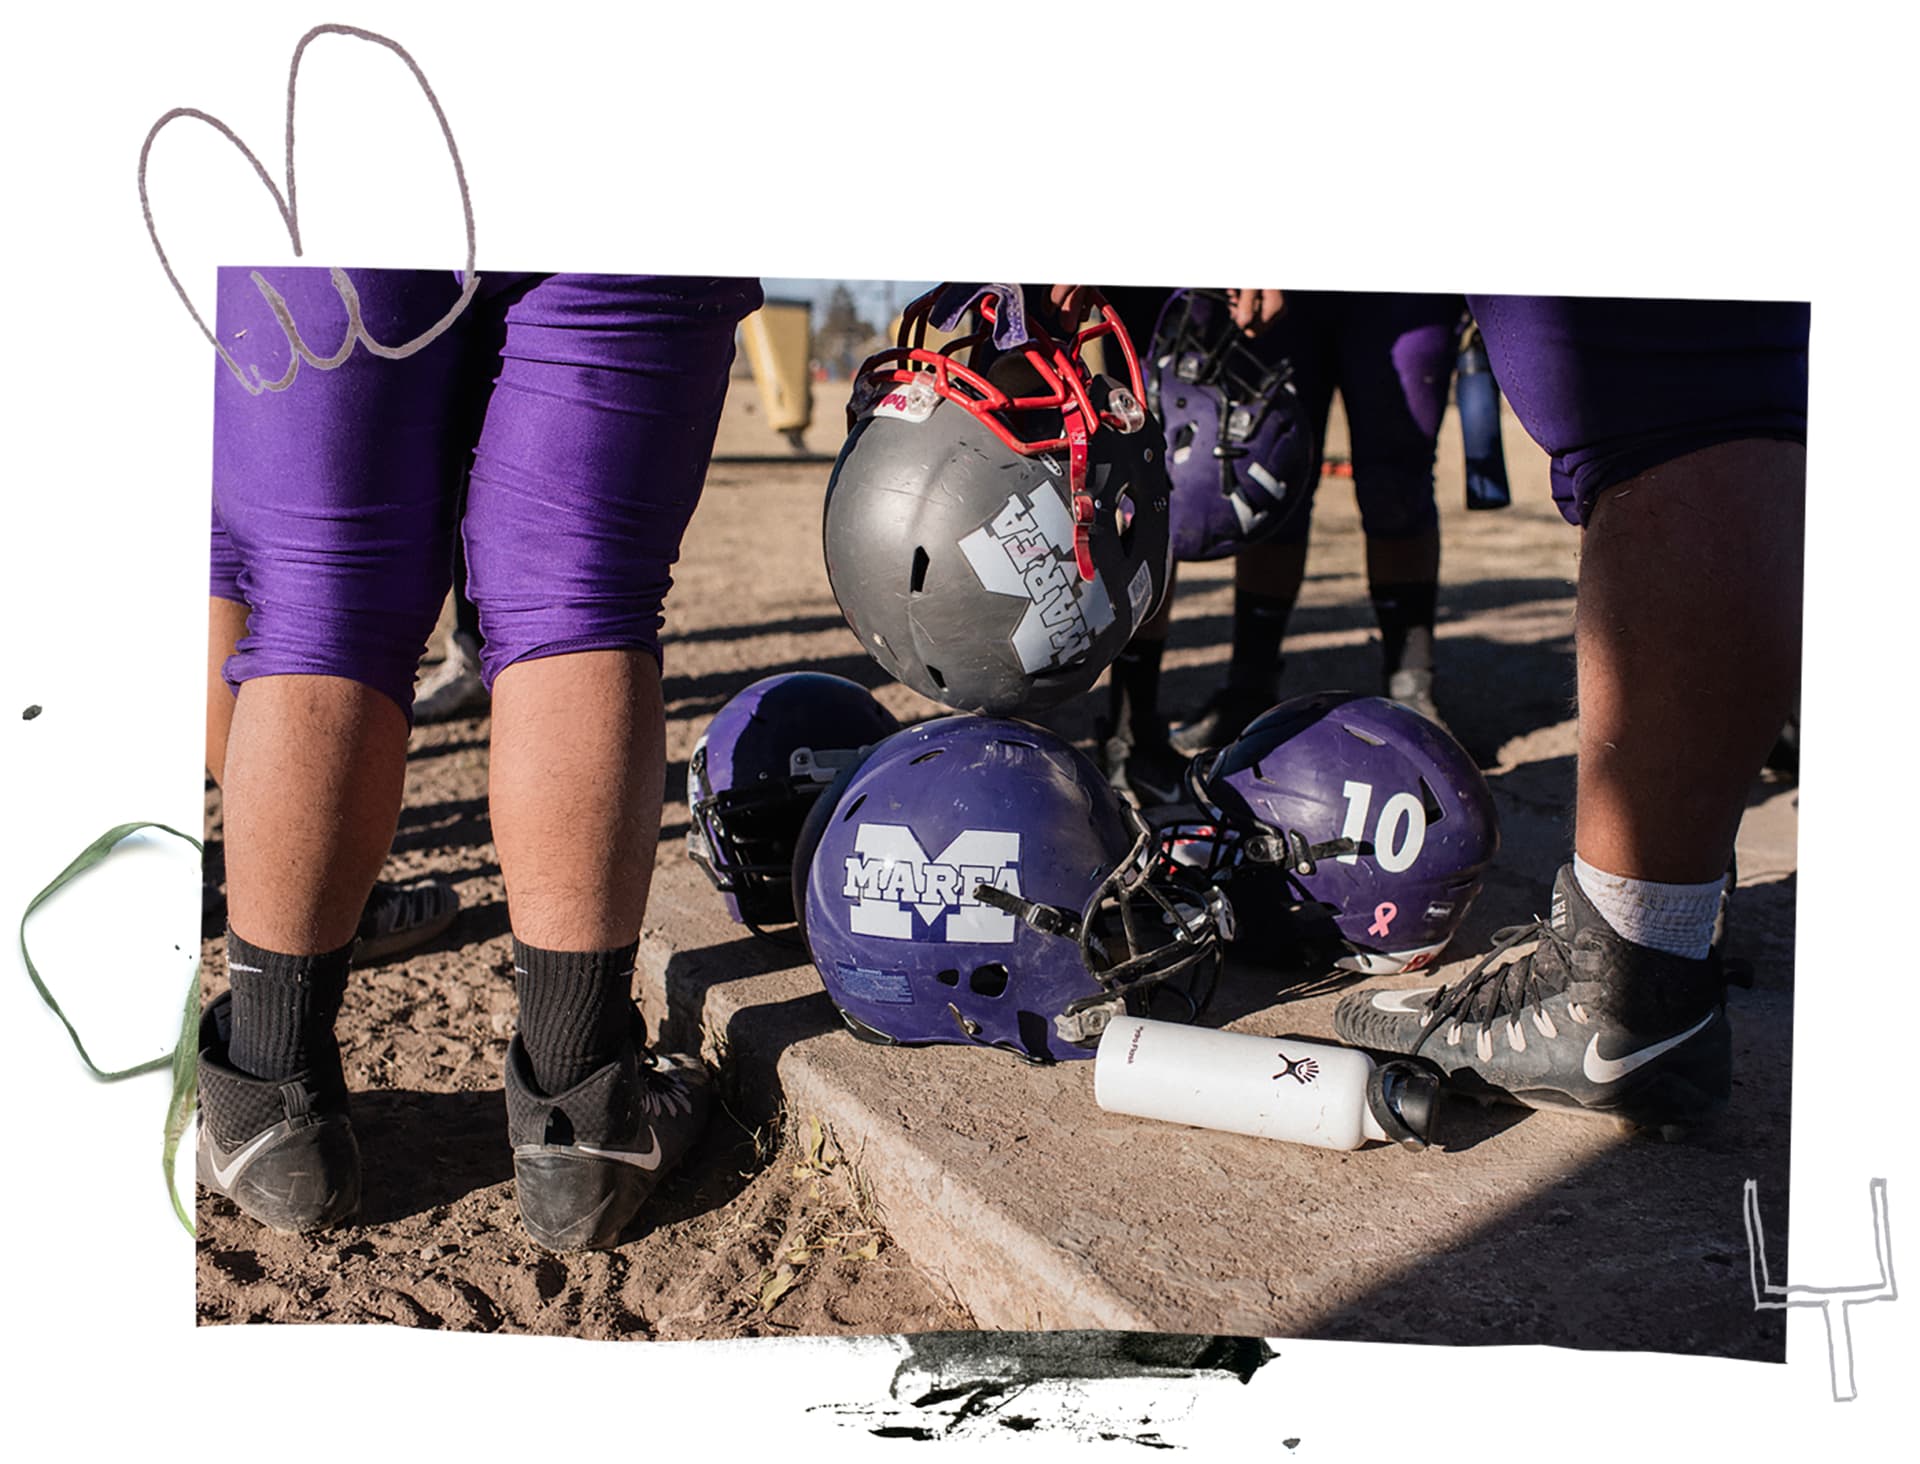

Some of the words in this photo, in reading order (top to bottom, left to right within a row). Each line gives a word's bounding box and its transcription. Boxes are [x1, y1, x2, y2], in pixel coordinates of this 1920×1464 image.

[990, 492, 1092, 667] MARFA
[1336, 780, 1427, 873] 10
[842, 855, 1026, 909] MARFA
